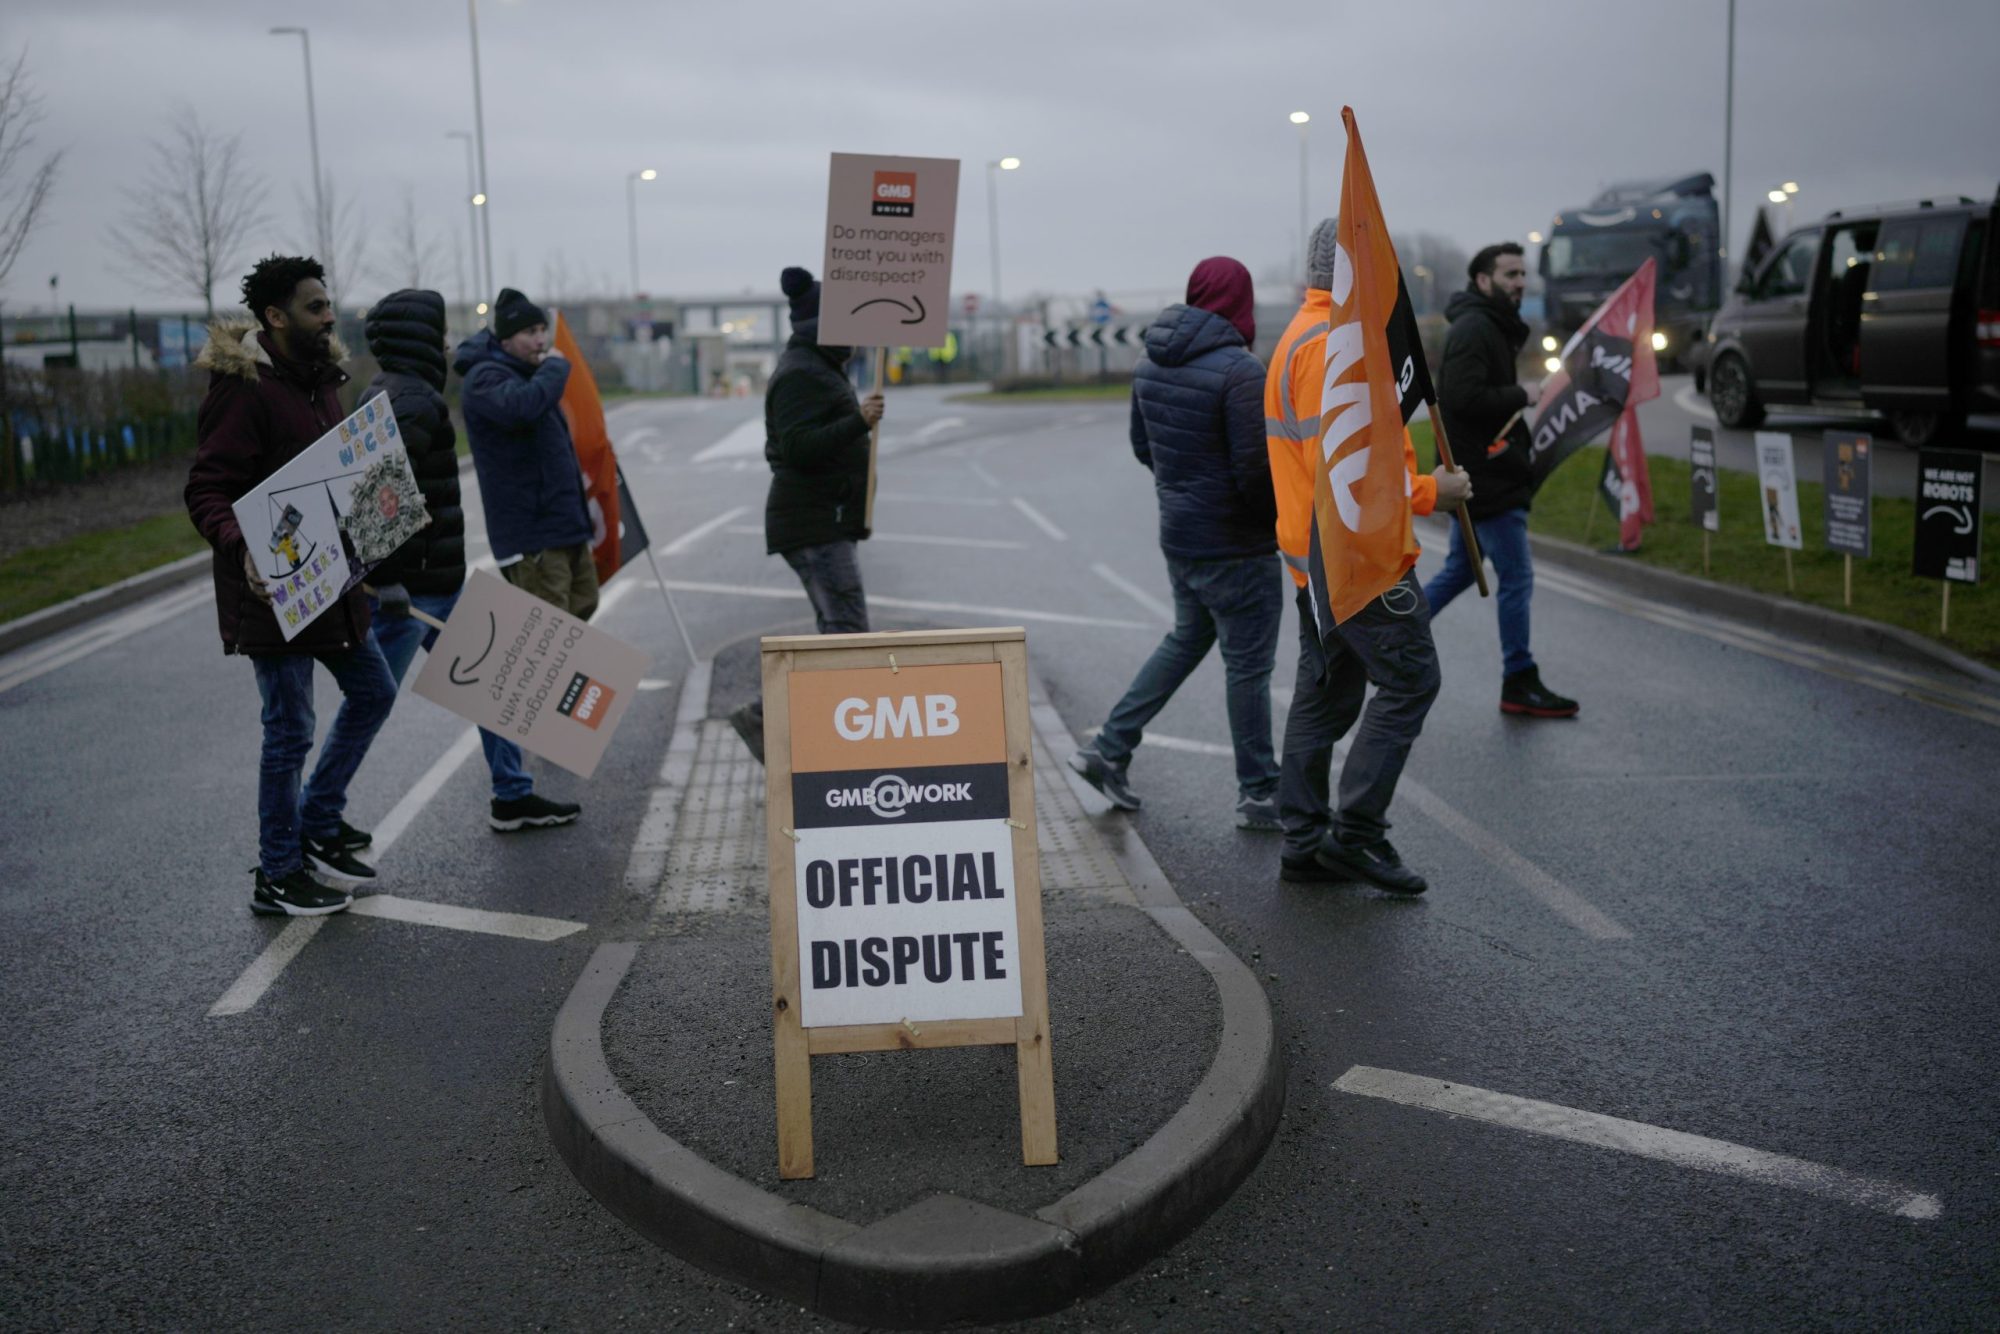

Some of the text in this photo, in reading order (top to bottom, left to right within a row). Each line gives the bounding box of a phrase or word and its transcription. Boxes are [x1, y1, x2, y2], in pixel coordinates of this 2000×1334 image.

[876, 205, 910, 214] UNION
[877, 184, 912, 199] GMB
[831, 247, 945, 265] treat you with
[833, 225, 946, 246] Do managers
[830, 267, 926, 286] disrespect?
[338, 400, 384, 445] BEZOS
[338, 416, 396, 467] WAGES
[1922, 482, 1975, 503] ROBOTS
[1924, 468, 1938, 481] WE
[1956, 471, 1975, 484] NOT
[271, 544, 340, 606] WORKER'S
[283, 579, 334, 629] WAGES
[487, 606, 542, 701] disrespect?
[497, 616, 564, 727] treat you with
[517, 625, 584, 736] Do managers
[562, 677, 583, 711] UNION
[576, 685, 602, 720] GMB
[833, 694, 960, 741] GMB
[825, 774, 973, 818] GMB@WORK
[805, 851, 1005, 909] OFFICIAL
[811, 931, 1006, 990] DISPUTE
